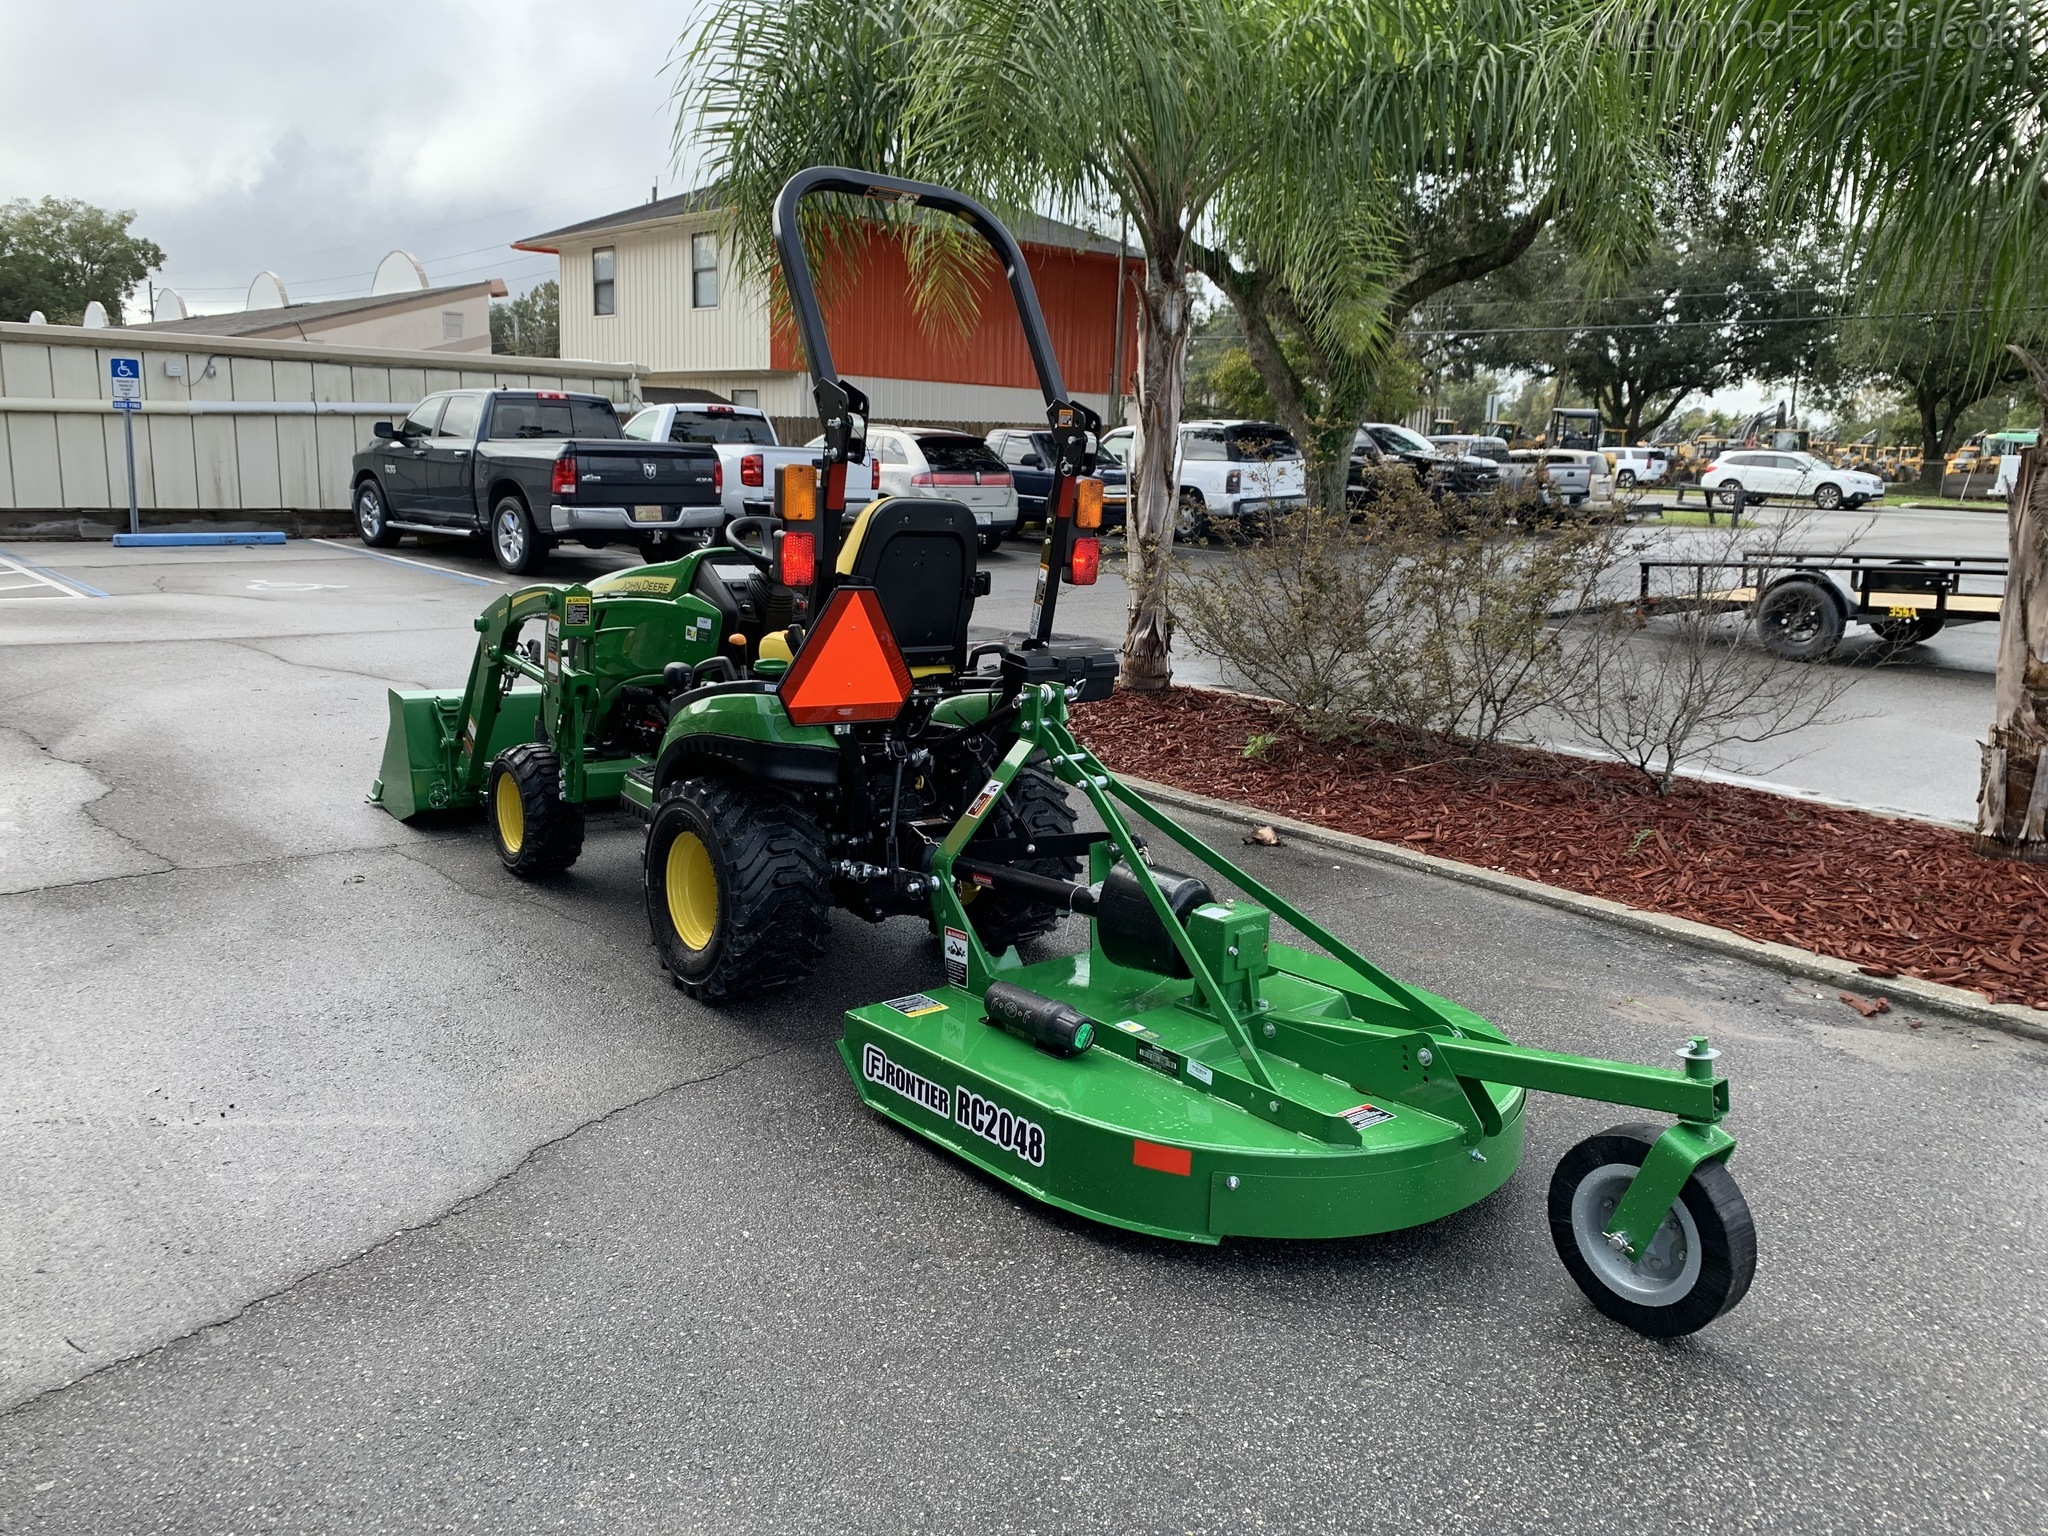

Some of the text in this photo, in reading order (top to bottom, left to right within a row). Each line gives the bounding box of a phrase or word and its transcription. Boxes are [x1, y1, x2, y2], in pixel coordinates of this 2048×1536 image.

[620, 579, 670, 593] JOHN DEERE
[864, 1045, 1044, 1165] FRONTIER RC2048
